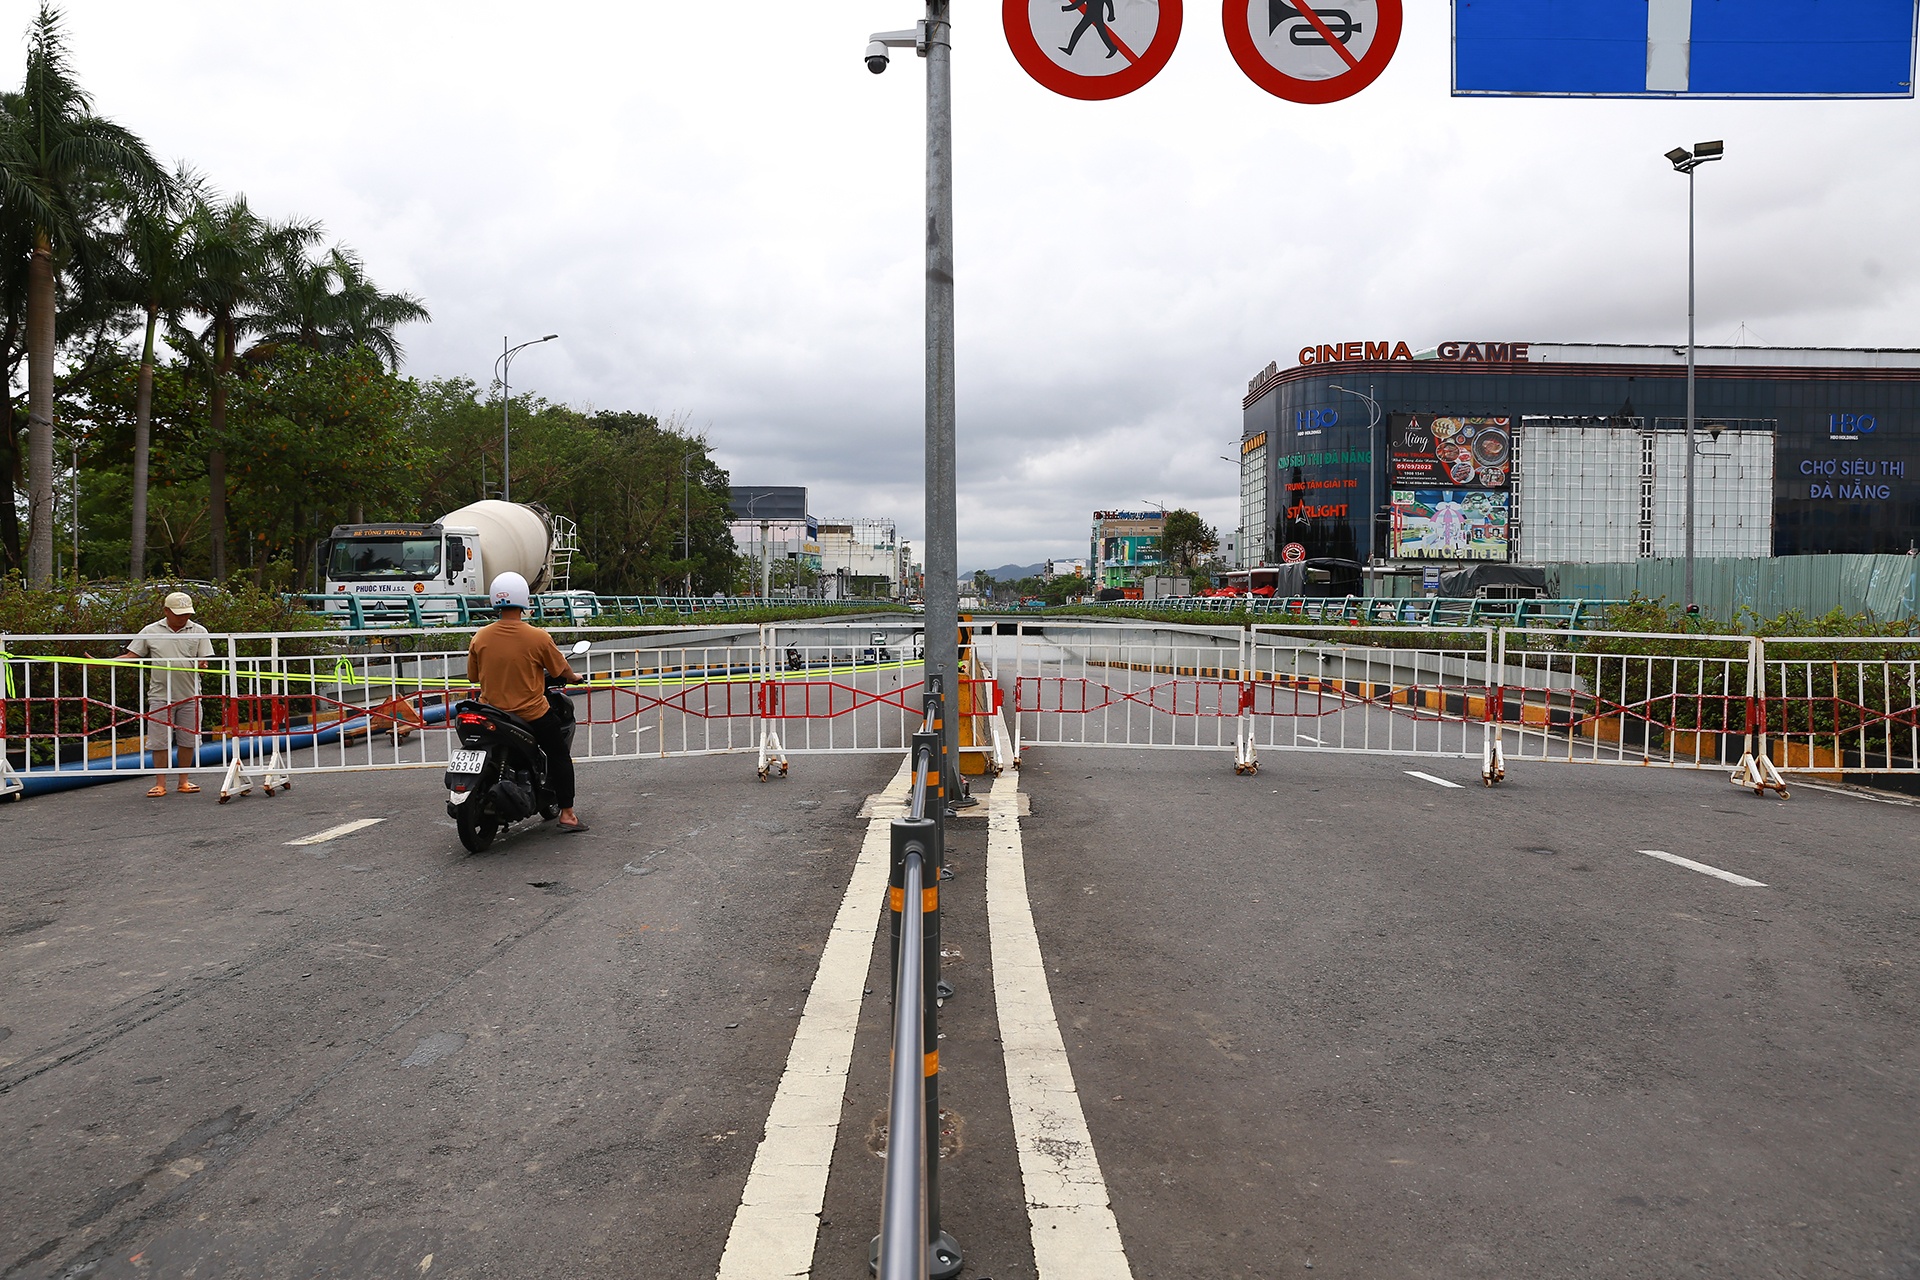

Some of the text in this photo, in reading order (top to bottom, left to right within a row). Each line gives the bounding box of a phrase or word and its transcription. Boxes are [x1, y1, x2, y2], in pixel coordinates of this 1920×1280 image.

[1299, 341, 1529, 365] CINEMA GAME
[1297, 408, 1339, 431] HBO
[1830, 413, 1878, 434] HBO
[1324, 449, 1339, 465] ĐÀ
[1800, 458, 1904, 478] CHỢ SIÊU THỊ
[1395, 492, 1414, 500] RIO
[1810, 478, 1891, 499] ĐÀ NẴNG
[1396, 543, 1418, 558] Khu
[1422, 546, 1440, 558] Vui
[1489, 547, 1508, 559] Em
[415, 584, 424, 593] 26
[456, 752, 480, 762] 43-D1
[450, 761, 481, 772] 963.48
